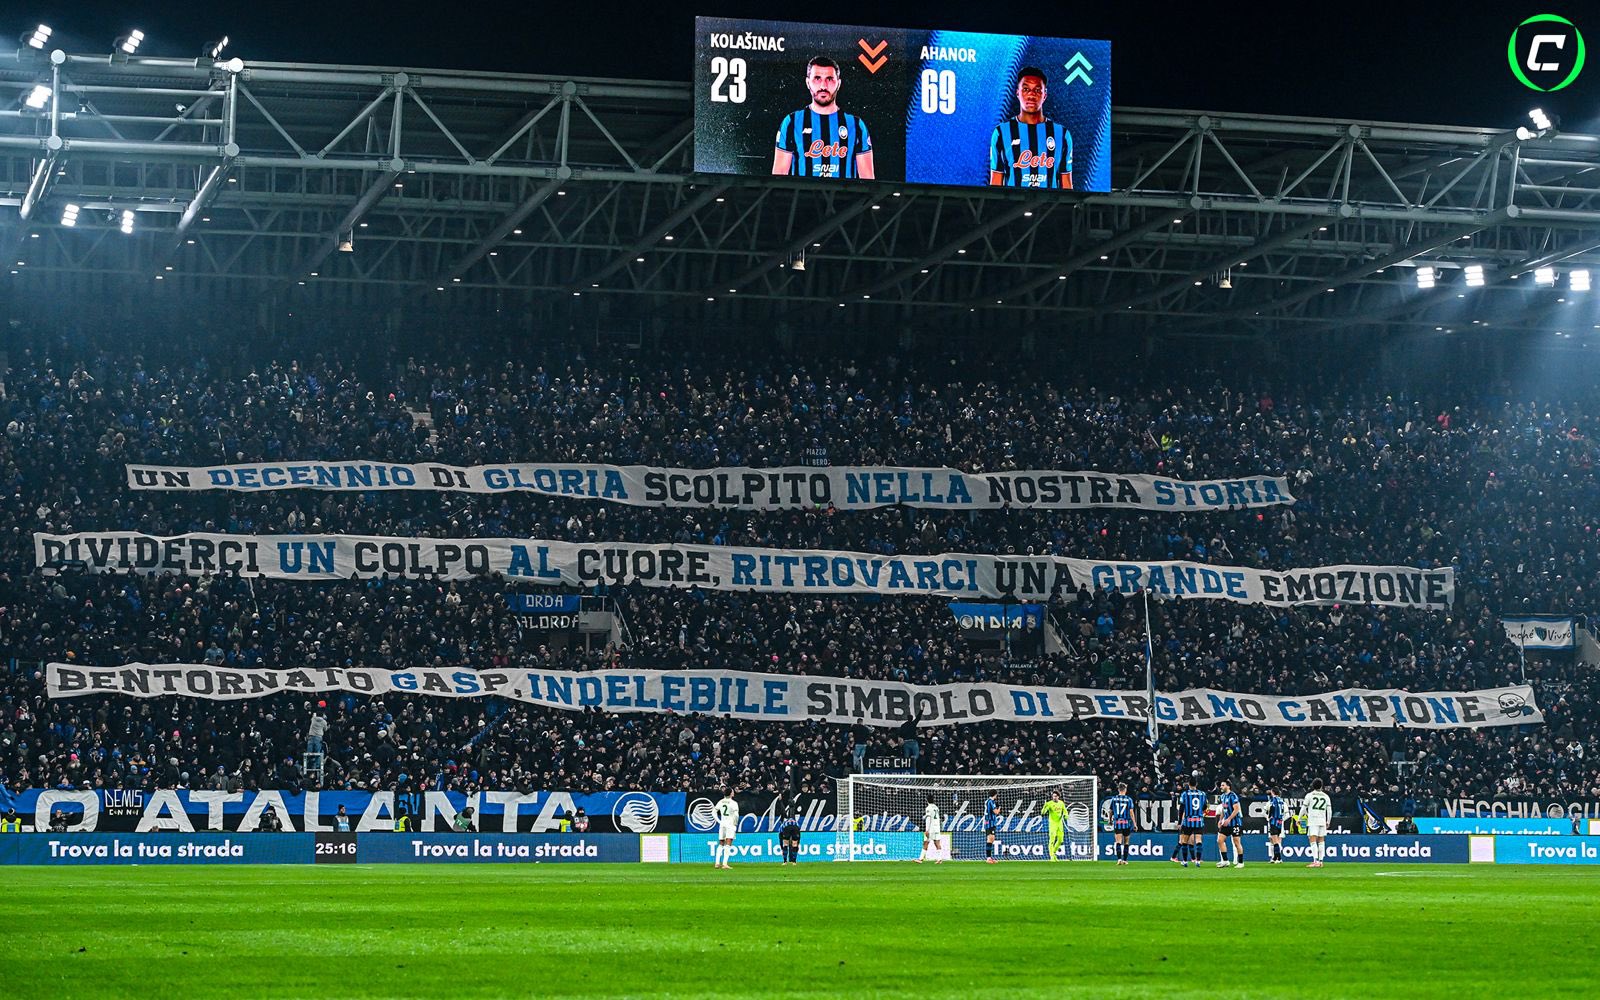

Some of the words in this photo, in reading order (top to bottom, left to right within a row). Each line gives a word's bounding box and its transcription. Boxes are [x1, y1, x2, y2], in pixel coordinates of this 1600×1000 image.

[710, 32, 785, 52] KOLAŠINAC
[920, 46, 976, 63] AHANOR
[710, 56, 747, 103] 23
[921, 69, 956, 115] 69
[804, 139, 848, 158] Lete
[1013, 150, 1055, 168] Lete
[132, 469, 190, 487] UN
[207, 465, 417, 488] DECENNIO
[429, 467, 470, 488] DI
[483, 468, 628, 499] GLORIA
[644, 472, 832, 505] SCOLPITO
[846, 473, 972, 504] NELLA
[985, 475, 1141, 504] NOSTRA
[1153, 480, 1290, 506] STORIA
[42, 537, 259, 572] DIVIDERCI
[277, 541, 336, 573] UN
[355, 541, 489, 575] COLPO
[507, 545, 561, 578] AL
[577, 549, 720, 587] CUORE,
[732, 553, 979, 592] RITROVARCI
[994, 562, 1077, 593] UNA
[1092, 564, 1248, 598] GRANDE
[1260, 570, 1447, 603] EMOZIONE
[526, 595, 563, 608] ORDA
[513, 615, 579, 629] ALORDA
[56, 667, 374, 695] BENTORNATO
[391, 671, 522, 698] GASP,
[527, 673, 788, 715] INDELEBILE
[807, 682, 996, 721] SIMBOLO
[1009, 690, 1053, 716] DI
[1066, 693, 1266, 721] BERGAMO
[1277, 695, 1486, 723] CAMPIONE
[868, 758, 890, 768] PER
[893, 758, 911, 768] CHI
[104, 789, 143, 808] DEMIS
[1192, 797, 1200, 811] 9
[1312, 797, 1326, 811] 22
[134, 789, 578, 833] ATALANTA
[722, 804, 730, 817] 2
[1115, 803, 1128, 815] 17
[1444, 798, 1542, 818] VECCHIA
[49, 841, 108, 857] Trova
[114, 840, 133, 857] la
[138, 842, 172, 857] tua
[177, 840, 244, 857] strada
[315, 843, 357, 855] 25:16
[412, 841, 469, 857] Trova
[474, 840, 493, 857] la
[498, 842, 530, 857] tua
[535, 840, 598, 857] strada
[707, 842, 762, 856] Tova
[798, 844, 820, 855] ua
[992, 841, 1044, 855] Trova
[1105, 840, 1163, 856] sada
[1265, 842, 1318, 857] Tova
[1342, 844, 1370, 857] tua
[1375, 841, 1431, 857] strada
[1528, 842, 1577, 858] Trova
[1582, 841, 1598, 858] la
